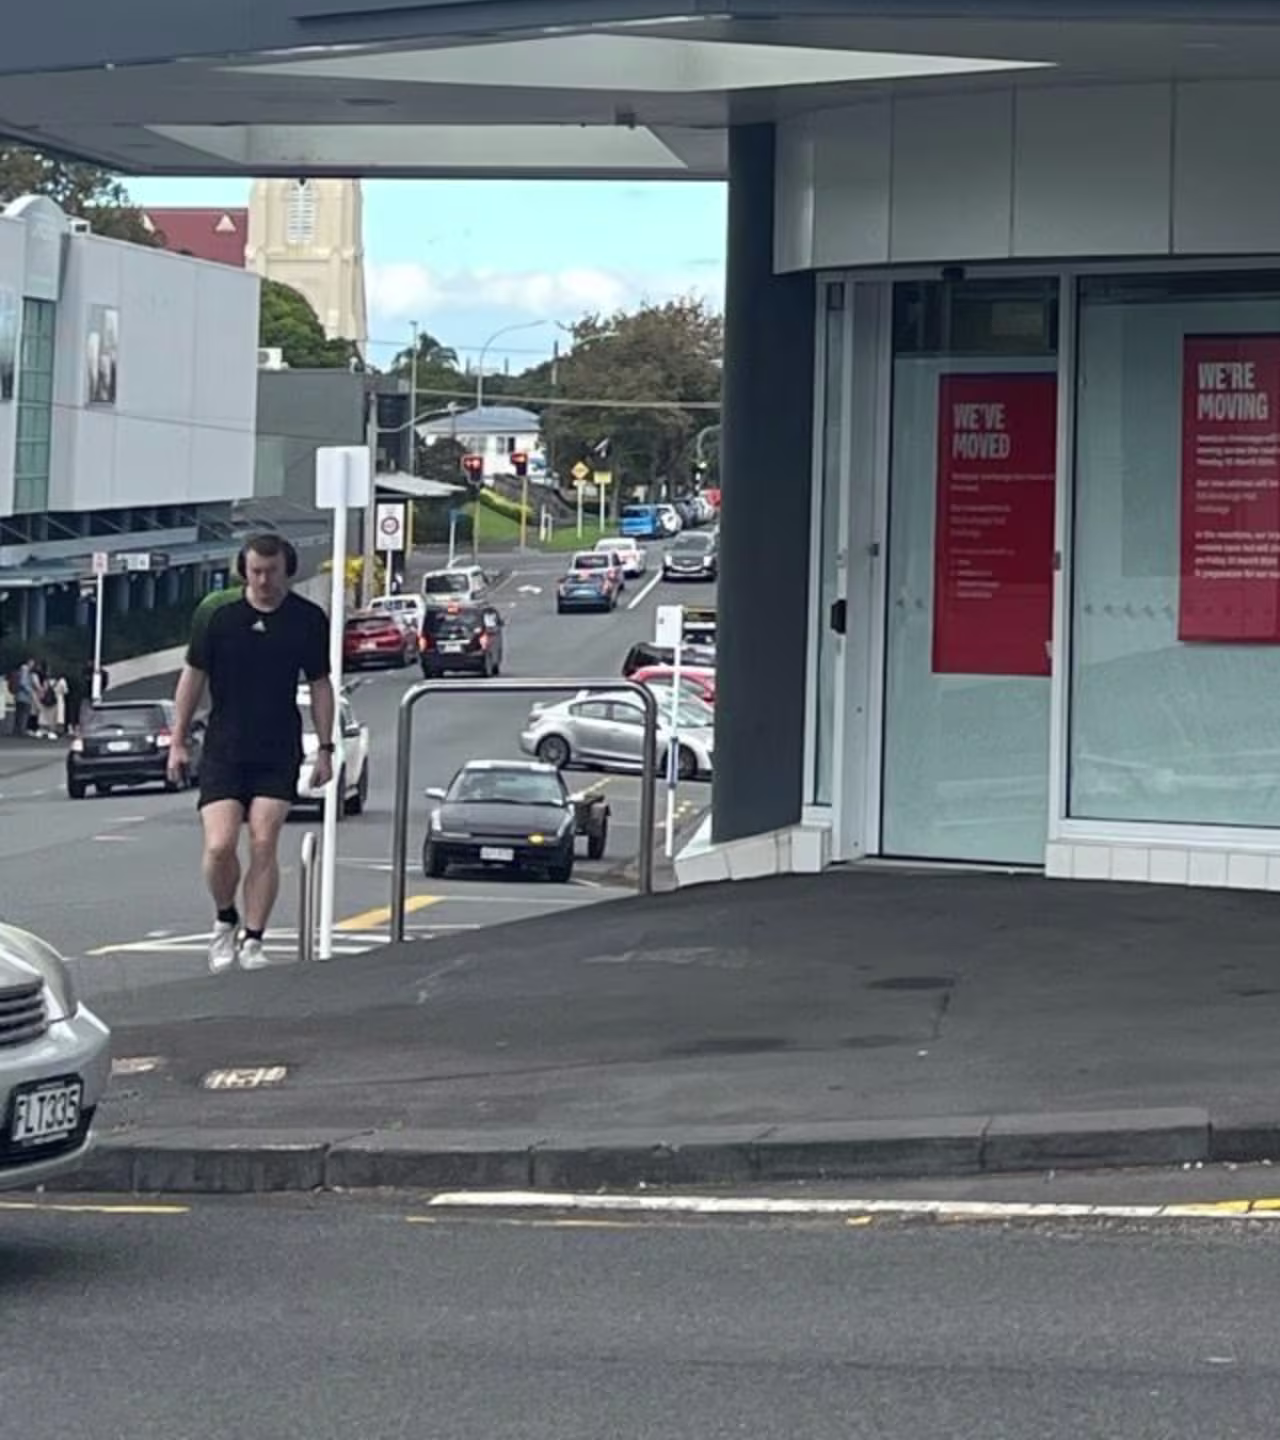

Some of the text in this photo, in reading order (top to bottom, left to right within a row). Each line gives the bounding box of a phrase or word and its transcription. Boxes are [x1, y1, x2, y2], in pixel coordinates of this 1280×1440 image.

[1197, 362, 1255, 391] WE'RE
[951, 402, 1006, 431] WE'VE
[1197, 392, 1269, 422] MOVING
[951, 432, 1011, 460] MOVED
